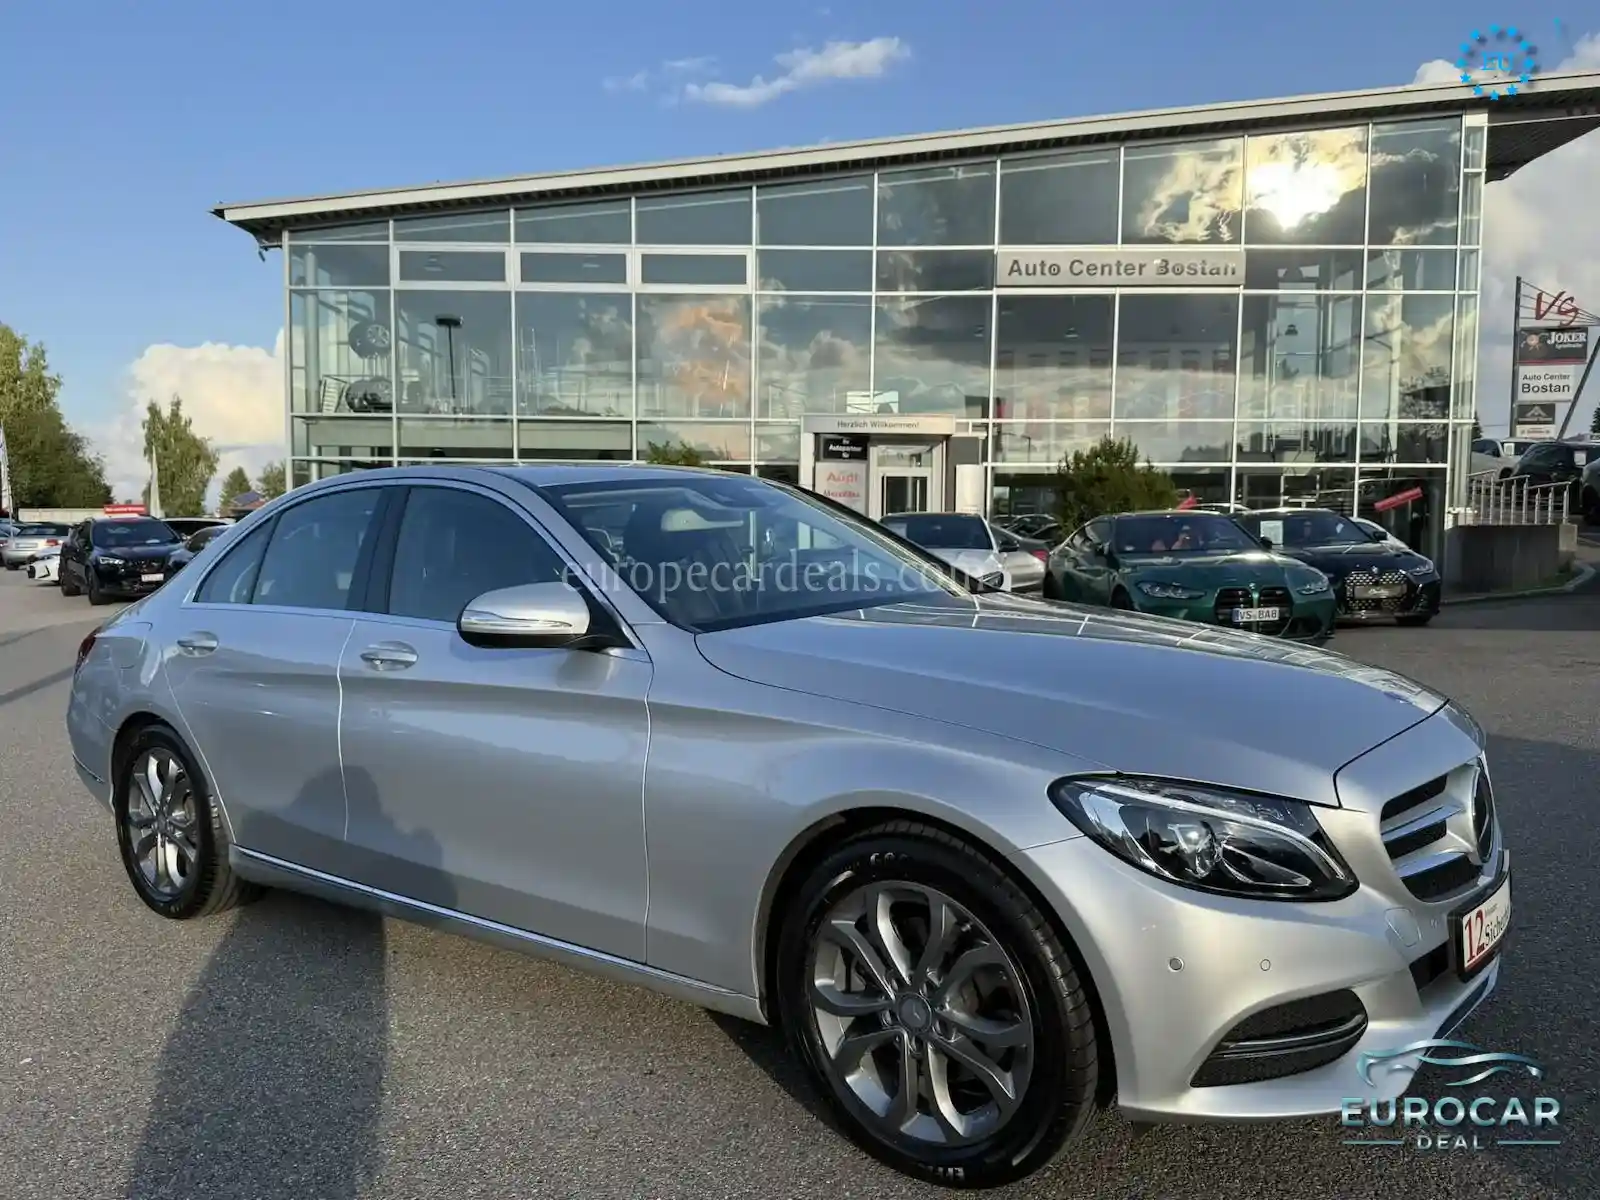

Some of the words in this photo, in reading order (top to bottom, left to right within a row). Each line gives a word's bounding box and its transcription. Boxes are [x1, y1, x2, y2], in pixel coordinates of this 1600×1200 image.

[1007, 259, 1062, 277] Auto
[1068, 259, 1147, 277] Center
[1153, 258, 1237, 277] Bostan
[1547, 331, 1587, 345] JOKER
[1522, 373, 1542, 381] Auto
[1544, 373, 1571, 381] Center
[1521, 383, 1571, 394] Bostan
[837, 420, 868, 429] Herzlich
[870, 420, 920, 429] Willkommen!
[826, 471, 859, 483] Audi
[1464, 909, 1485, 963] 12
